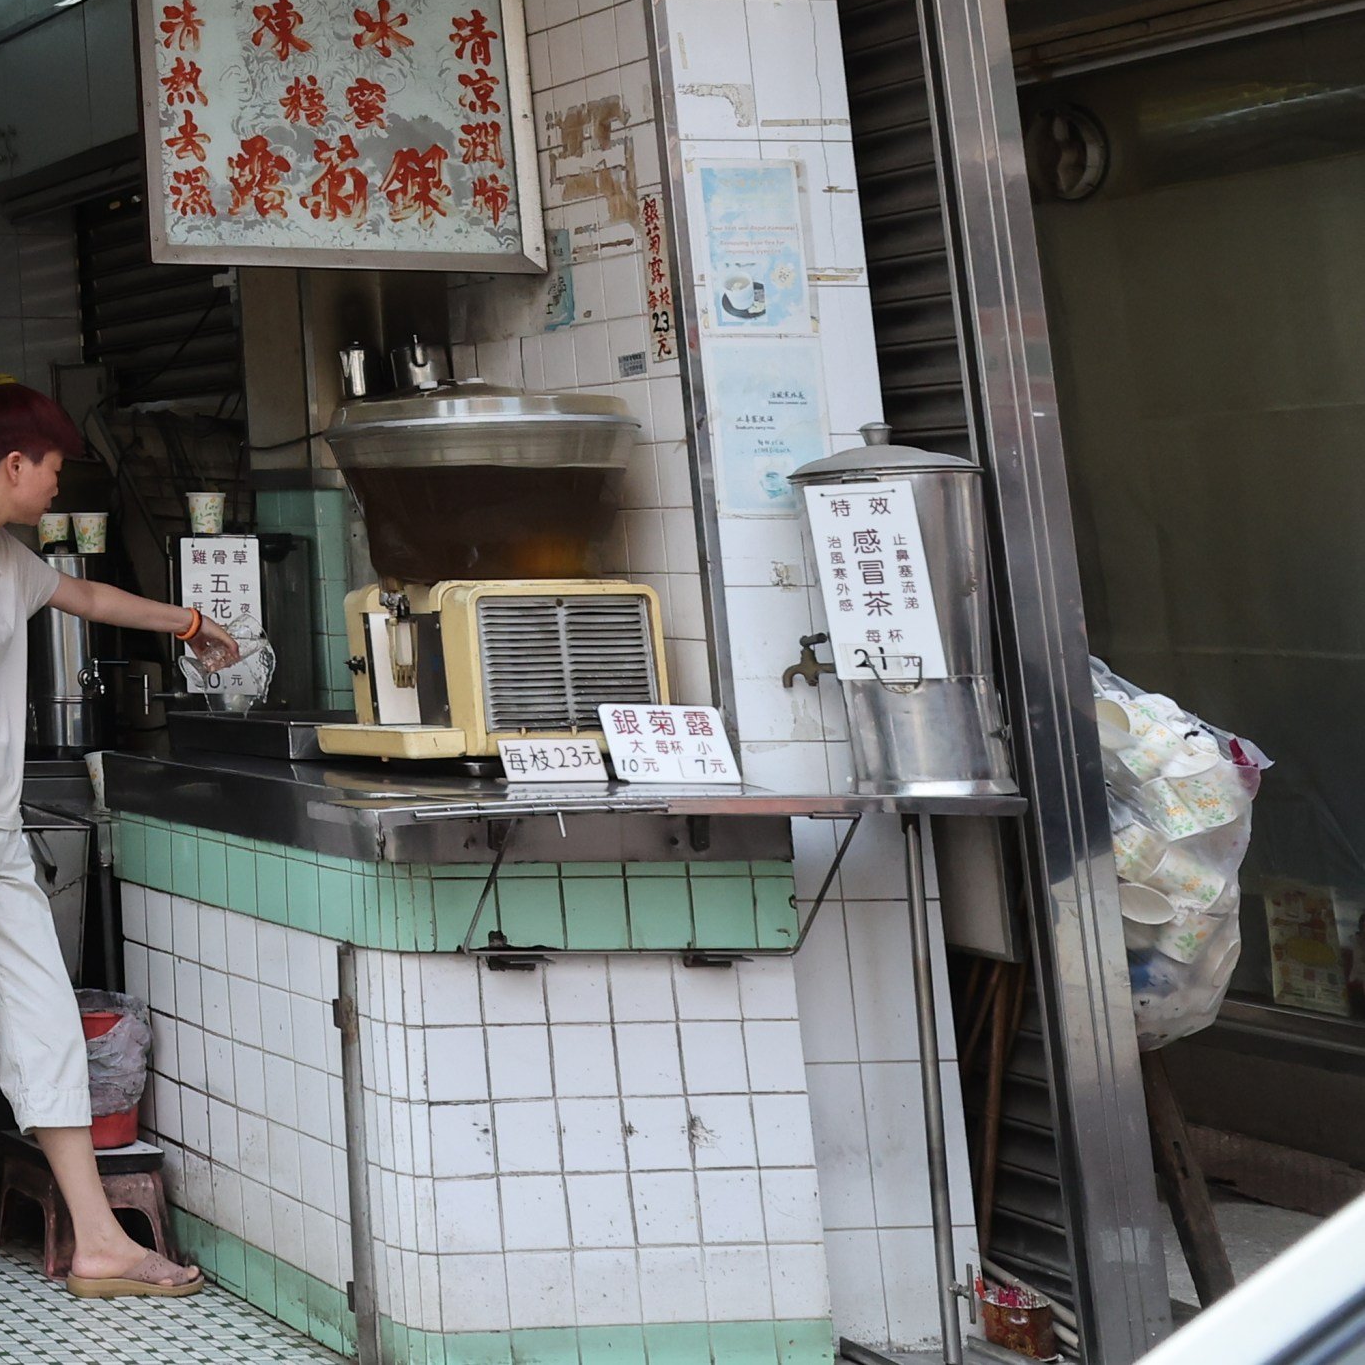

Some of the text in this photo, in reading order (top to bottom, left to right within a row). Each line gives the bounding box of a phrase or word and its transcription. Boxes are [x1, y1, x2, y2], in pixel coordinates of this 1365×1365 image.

[831, 497, 892, 517] 特效
[191, 549, 248, 565] 雞骨草
[827, 535, 854, 612] 治風寒外感
[853, 528, 893, 617] 感冒茶
[866, 628, 904, 644] 每杯
[611, 709, 714, 736] 銀菊露
